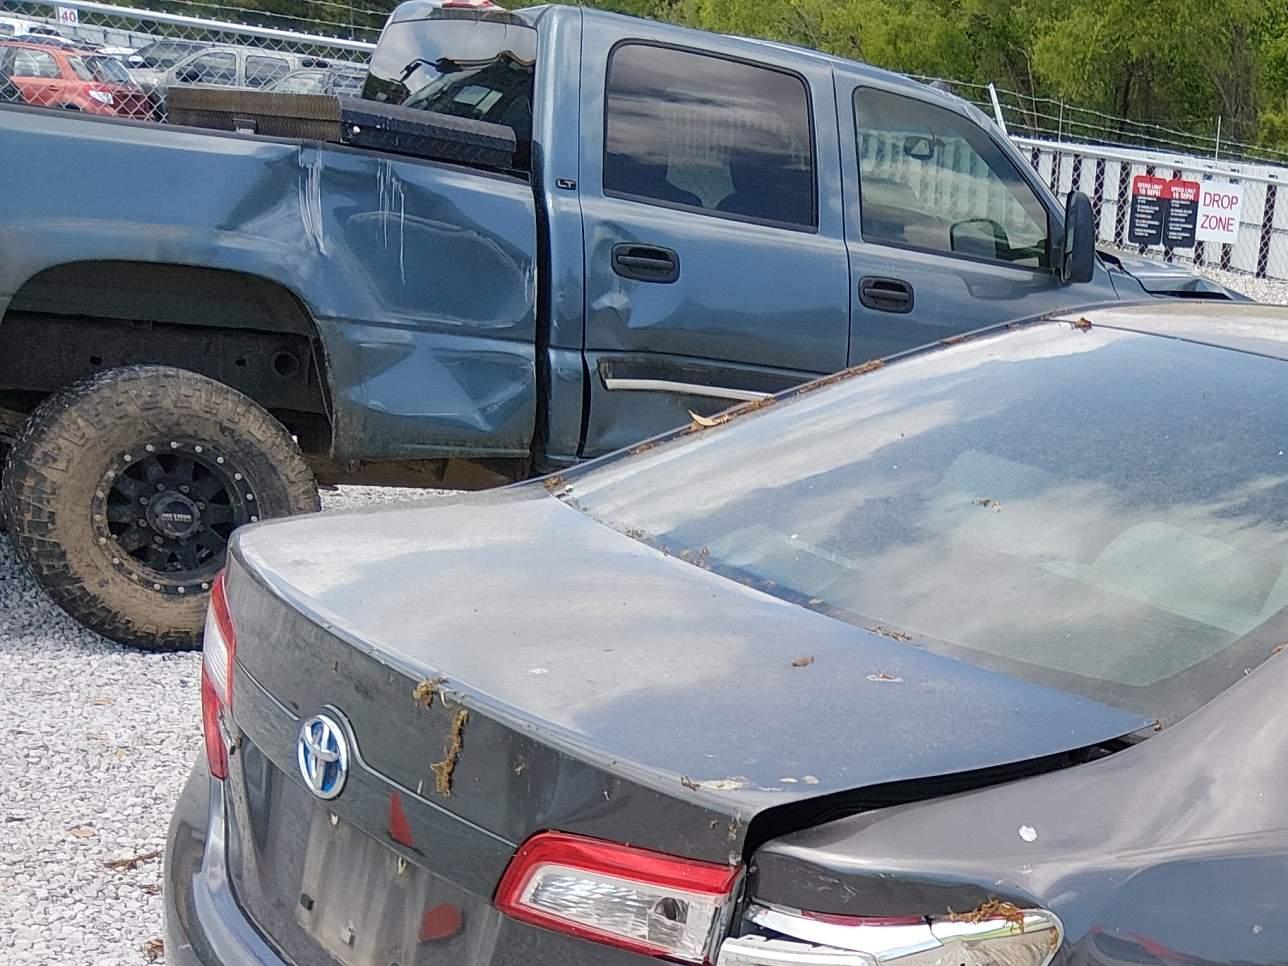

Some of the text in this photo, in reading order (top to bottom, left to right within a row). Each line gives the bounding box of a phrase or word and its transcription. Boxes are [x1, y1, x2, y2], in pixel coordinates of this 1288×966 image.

[61, 10, 77, 23] 40
[557, 180, 575, 189] LT
[1203, 192, 1239, 210] DROP
[1200, 214, 1236, 233] ZONE
